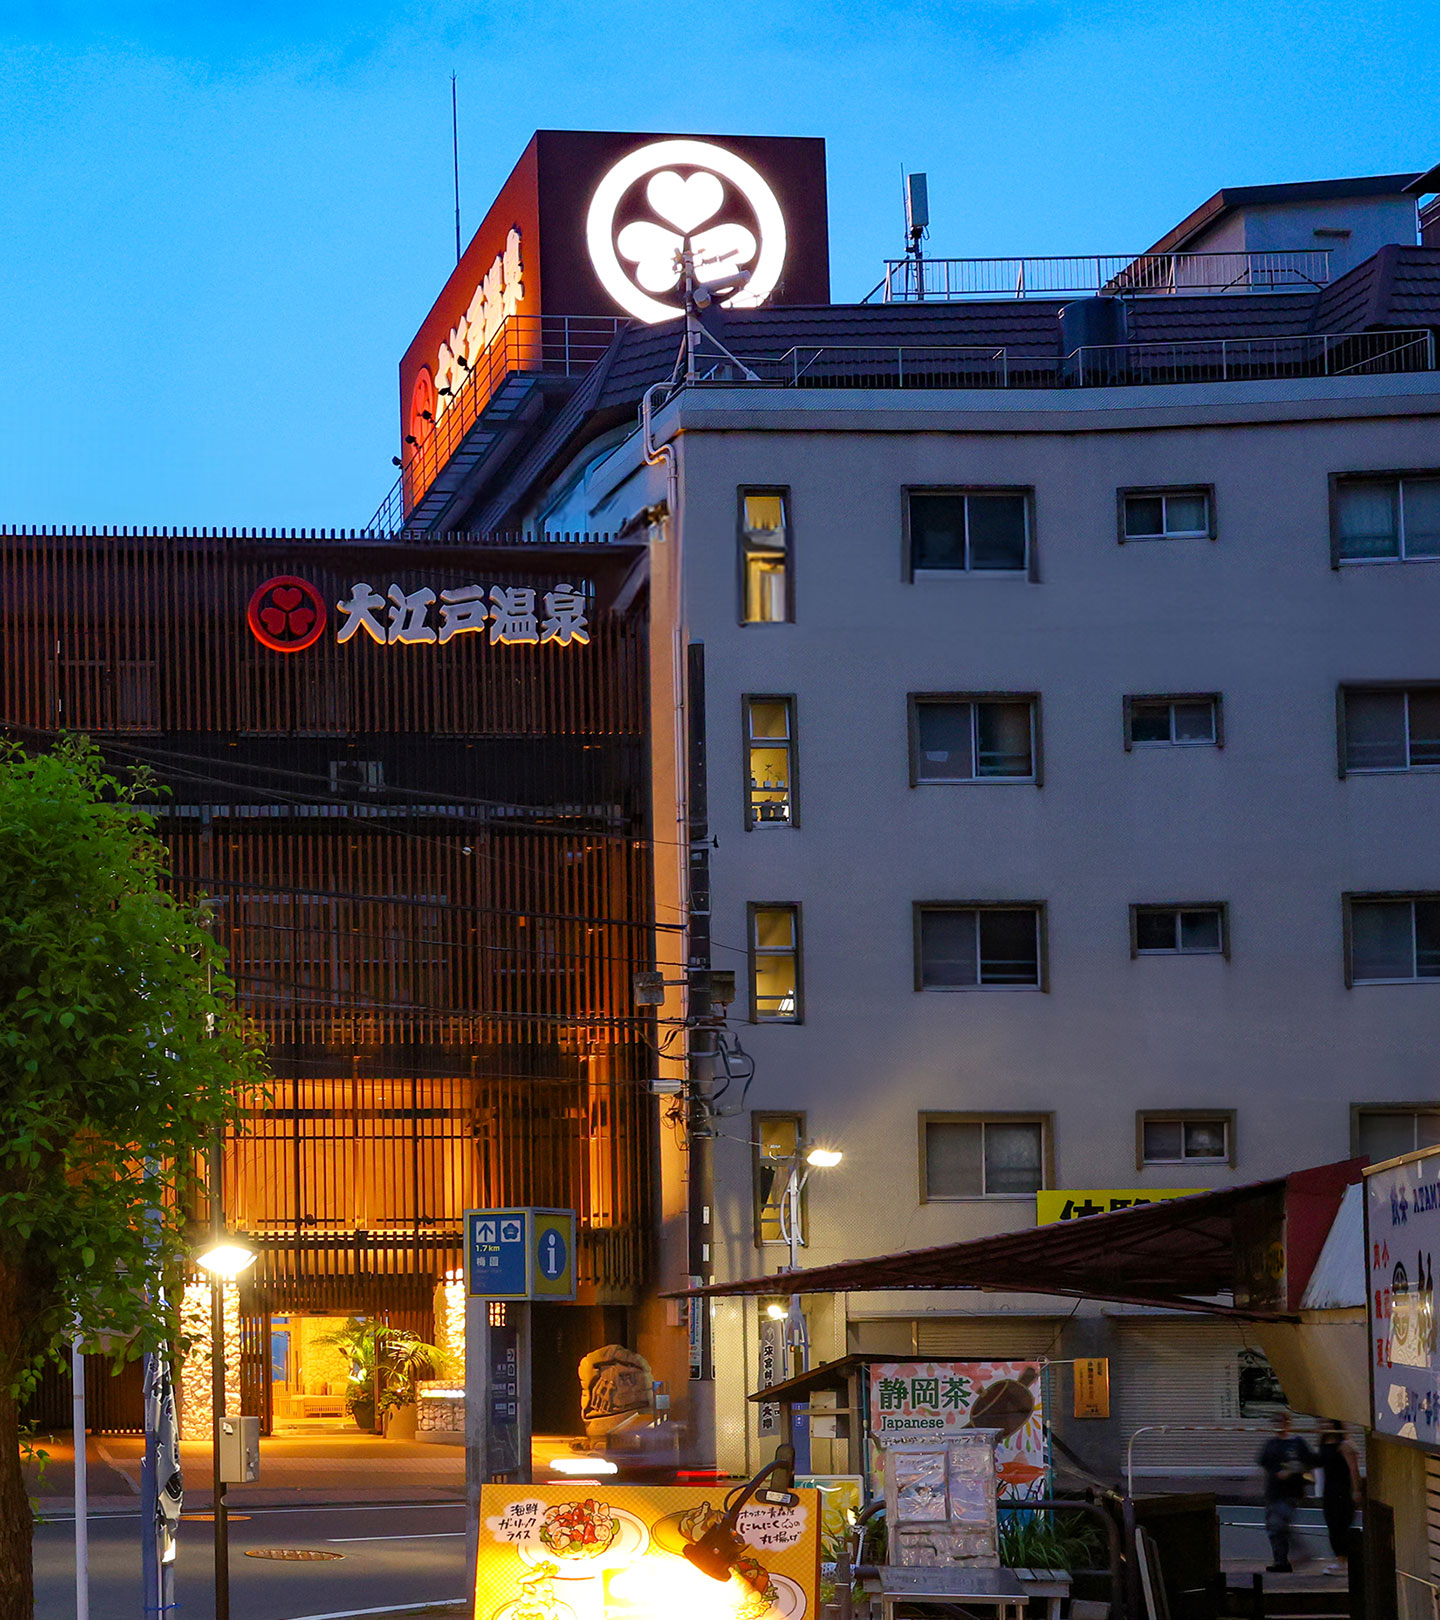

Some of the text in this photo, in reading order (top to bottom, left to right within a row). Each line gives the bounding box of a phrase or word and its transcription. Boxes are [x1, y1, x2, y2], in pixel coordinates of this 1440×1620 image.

[336, 582, 591, 646] 大江戸温泉
[878, 1377, 972, 1410] 静岡茶
[881, 1416, 945, 1431] Japanese
[510, 1503, 538, 1516] 海鮮
[498, 1518, 536, 1530] ガーリック
[507, 1530, 531, 1541] ライス
